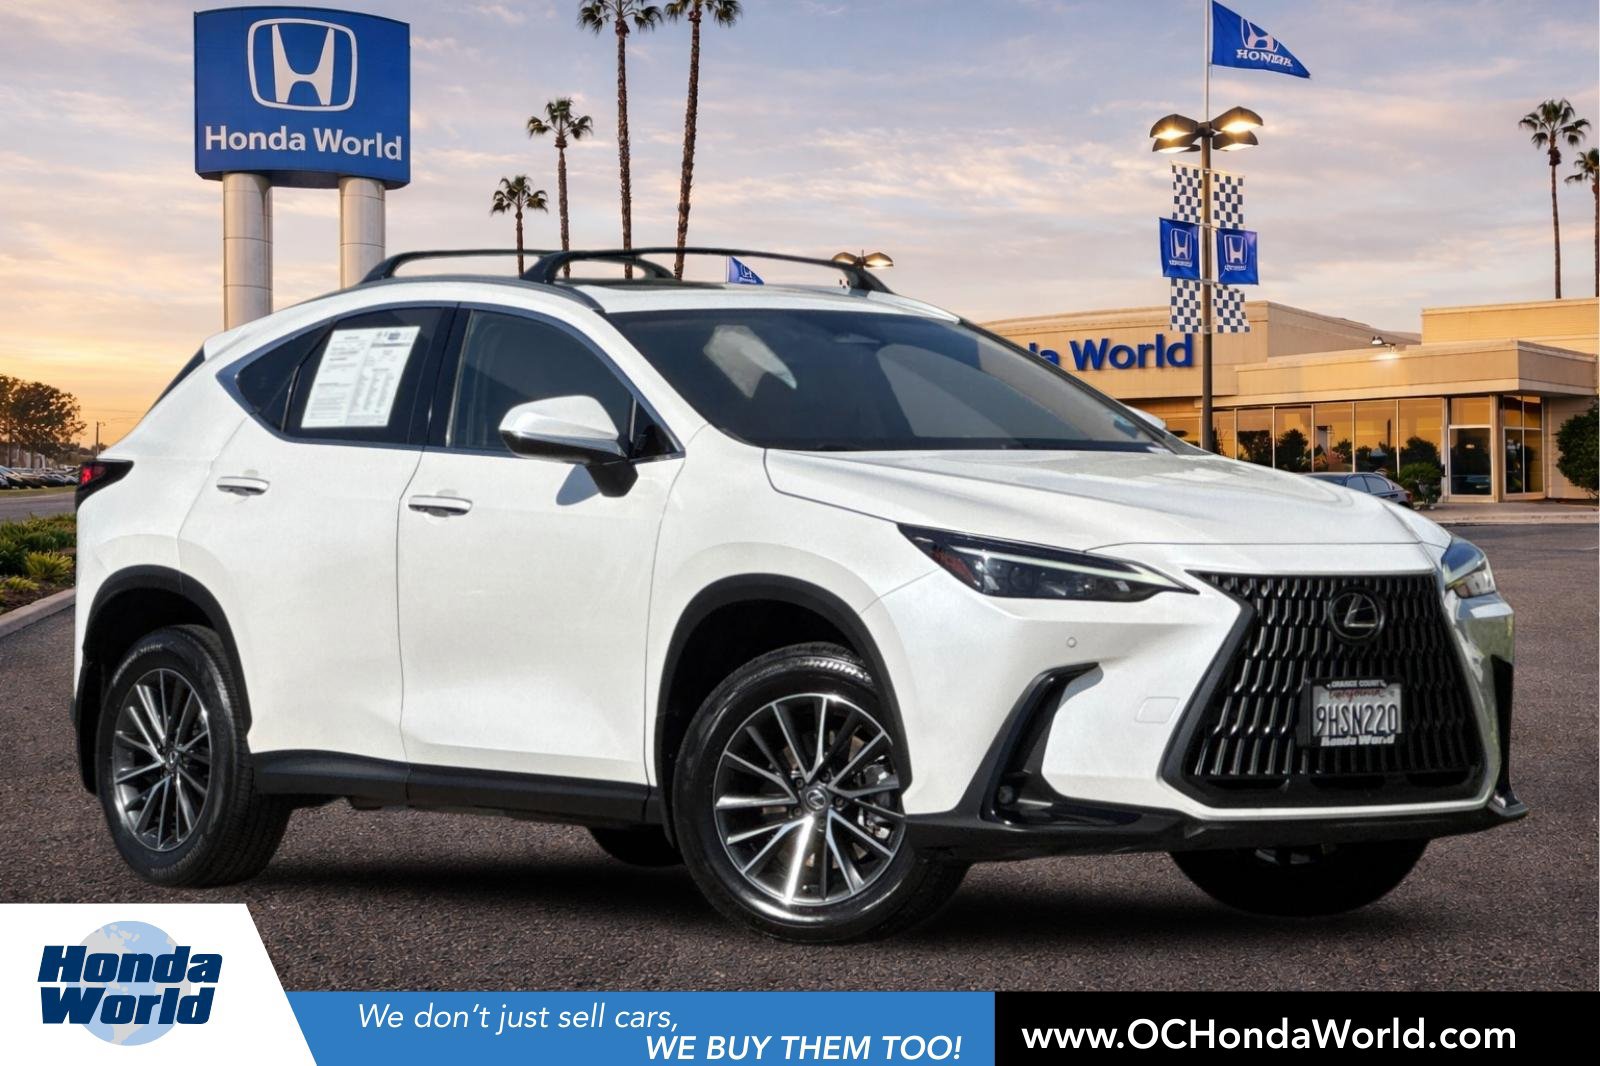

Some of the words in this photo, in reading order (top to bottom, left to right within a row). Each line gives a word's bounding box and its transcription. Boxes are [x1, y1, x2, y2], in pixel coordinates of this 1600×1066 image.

[205, 125, 306, 151] Honda
[313, 127, 402, 161] World
[1069, 333, 1194, 371] World
[1316, 703, 1398, 736] 9HSN220
